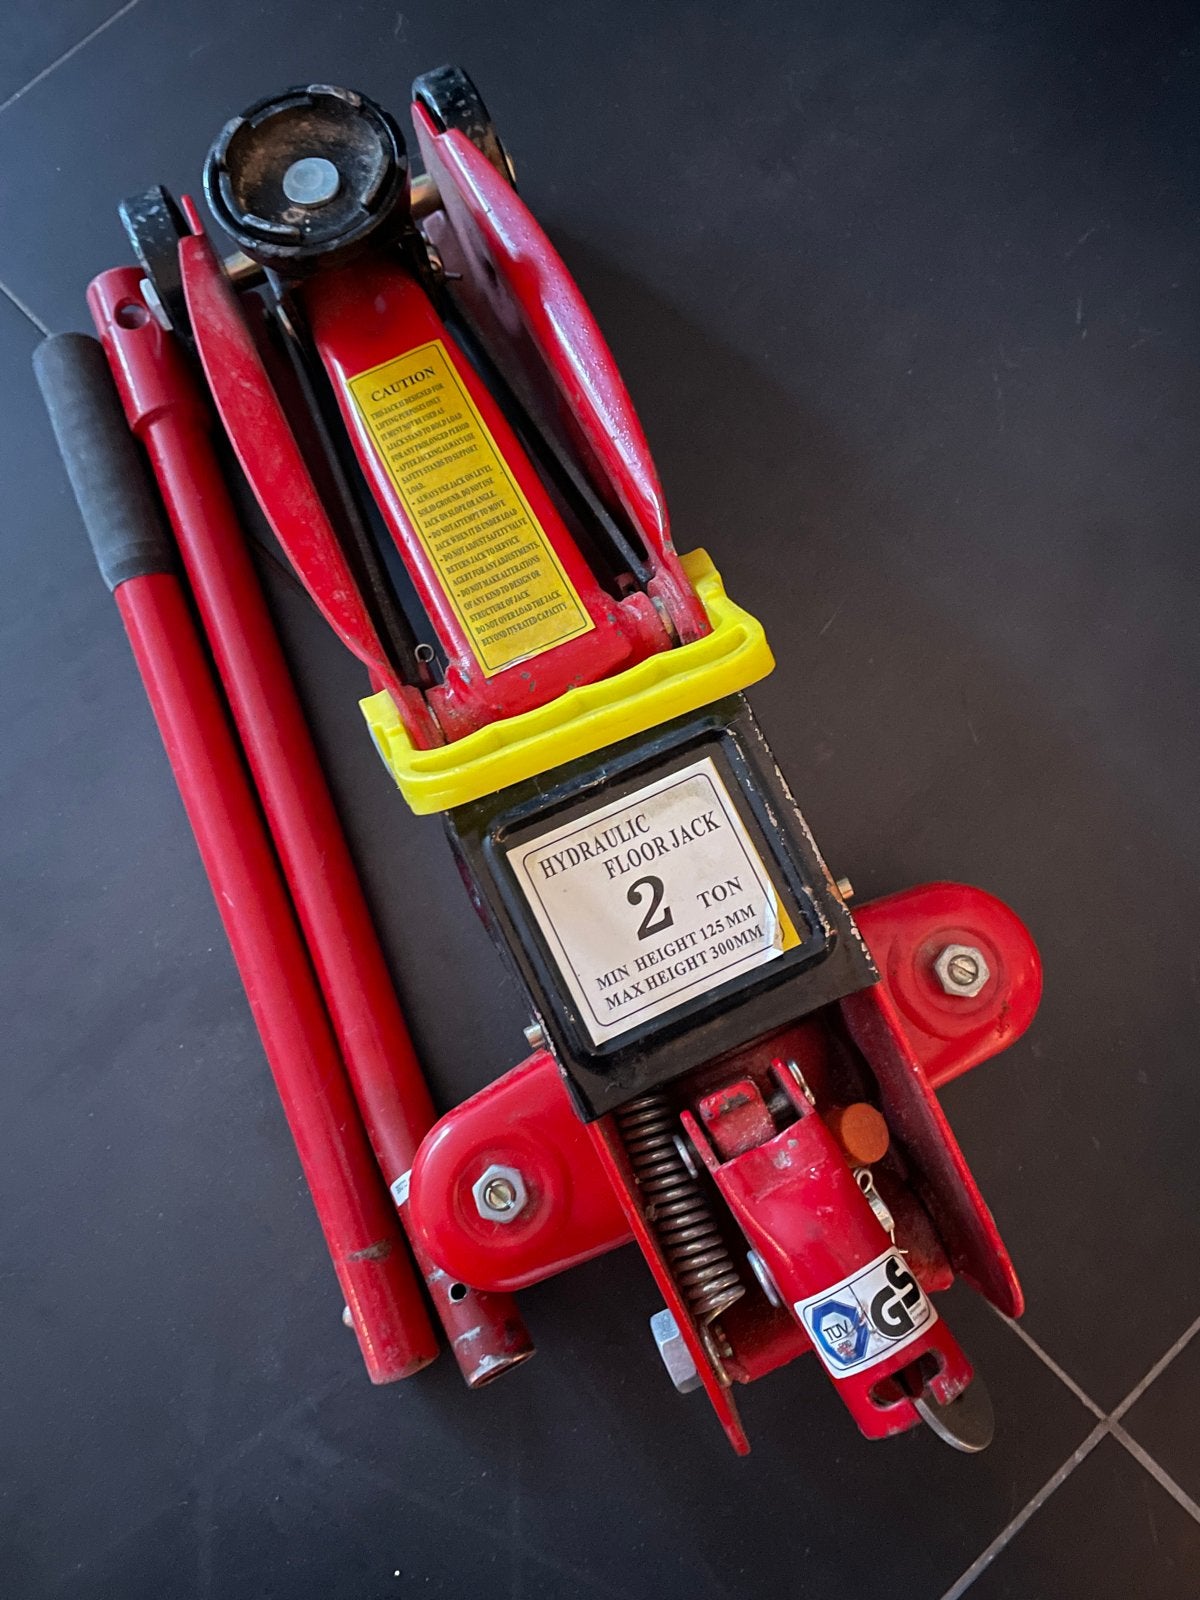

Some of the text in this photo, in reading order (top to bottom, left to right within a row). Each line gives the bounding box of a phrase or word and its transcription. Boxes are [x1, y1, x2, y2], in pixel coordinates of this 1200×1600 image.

[369, 365, 436, 402] CAUTION
[383, 402, 399, 414] JACK
[403, 387, 432, 405] DESIGNED
[431, 382, 444, 392] FOR
[375, 395, 441, 431] LIFTING PURPOSES ONLY
[386, 426, 403, 438] MUST
[401, 420, 415, 431] NOT
[421, 410, 437, 421] USED
[436, 406, 445, 415] AS
[403, 429, 424, 443] STAND
[421, 425, 432, 434] TO
[429, 418, 447, 431] HOLD
[445, 411, 463, 423] LOAD
[390, 421, 470, 462] FOR ANY PROLONGED PERIOD
[398, 432, 475, 472] AFTER JACKING ALWAYS USE
[400, 443, 478, 483] SAFETY STANDS TO SUPPORT
[415, 463, 493, 504] ALWAYS USE JACK ON LEVEL
[417, 503, 436, 517] SOLID
[461, 487, 471, 496] DO
[469, 482, 483, 493] NOT
[481, 476, 494, 487] USE
[423, 515, 440, 528] JACK
[438, 511, 448, 521] ON
[447, 503, 467, 517] SLOPE
[465, 499, 476, 508] OR
[431, 499, 505, 538] DO NOT ATTEMPT TO MOVE
[434, 507, 518, 551] JACK WHEN IT IS UNDER LOAD
[442, 517, 527, 561] DO NOT ADJUST SAFETY VALVE
[469, 550, 487, 563] JACK
[485, 546, 495, 556] TO
[493, 535, 520, 552] SERVICE
[471, 566, 484, 577] FOR
[483, 560, 497, 572] ANY
[460, 554, 540, 597] DO NOT MAKE ALTERATIONS
[463, 569, 541, 610] OF ANY KIND TO DESIGN OR
[469, 589, 530, 622] STRUCTURE OF JACK
[475, 624, 486, 634] DO
[484, 619, 498, 630] NOT
[531, 597, 545, 608] THE
[543, 589, 561, 602] JACK
[481, 601, 567, 646] BEYOND ITS RATED CAPACITY
[539, 815, 649, 879] HYDRAULIC
[604, 811, 720, 879] FLOOR JACK
[627, 876, 742, 940] 2 TON
[596, 905, 755, 990] MIN HEIGHT 125 MM
[606, 982, 645, 1010] MAX
[645, 951, 707, 990] HEIGHT
[871, 1257, 920, 1337] GS
